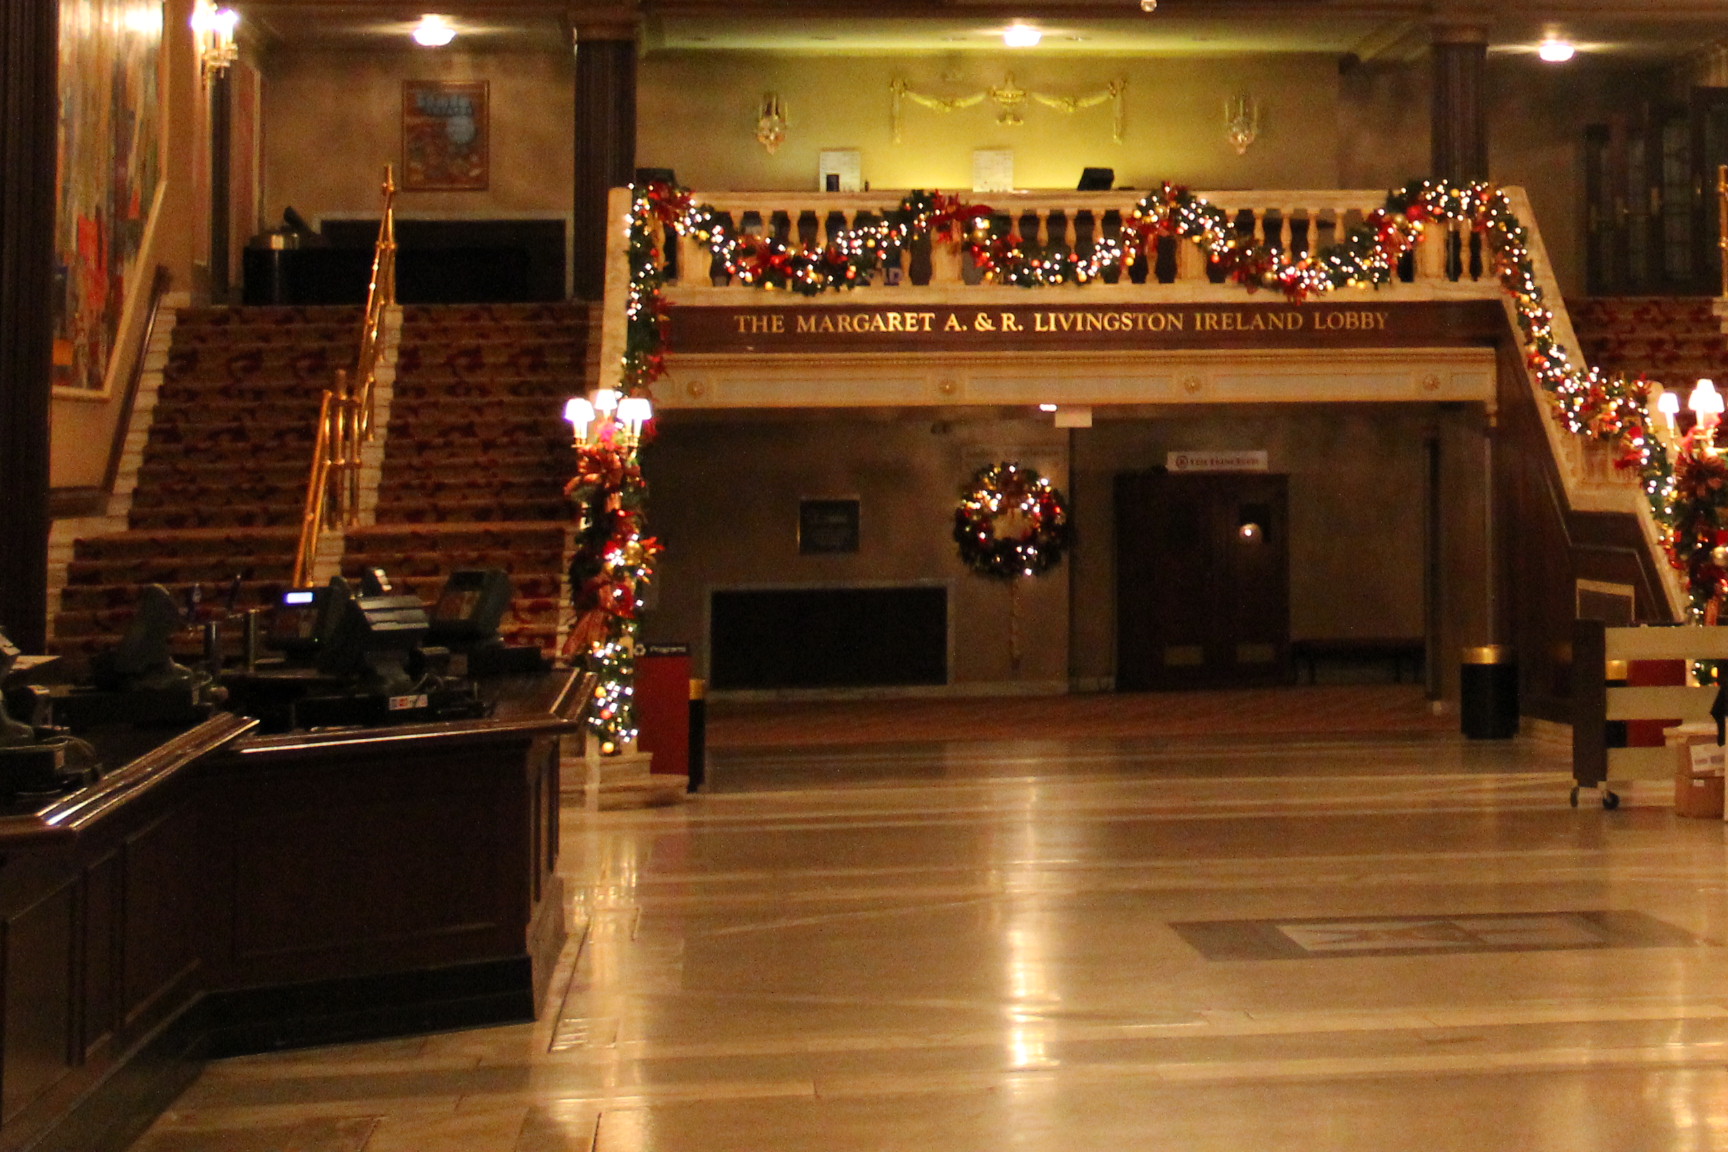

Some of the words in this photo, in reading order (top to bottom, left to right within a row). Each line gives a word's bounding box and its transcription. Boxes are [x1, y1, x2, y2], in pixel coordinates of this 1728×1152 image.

[734, 315, 785, 333] THE
[796, 313, 935, 333] MARGARET
[944, 313, 967, 332] A.
[974, 313, 996, 331] &
[1001, 312, 1024, 332] R.
[1034, 312, 1184, 332] LIVINGSTON
[1195, 312, 1303, 331] IRELAND
[1314, 311, 1389, 330] LOBBY
